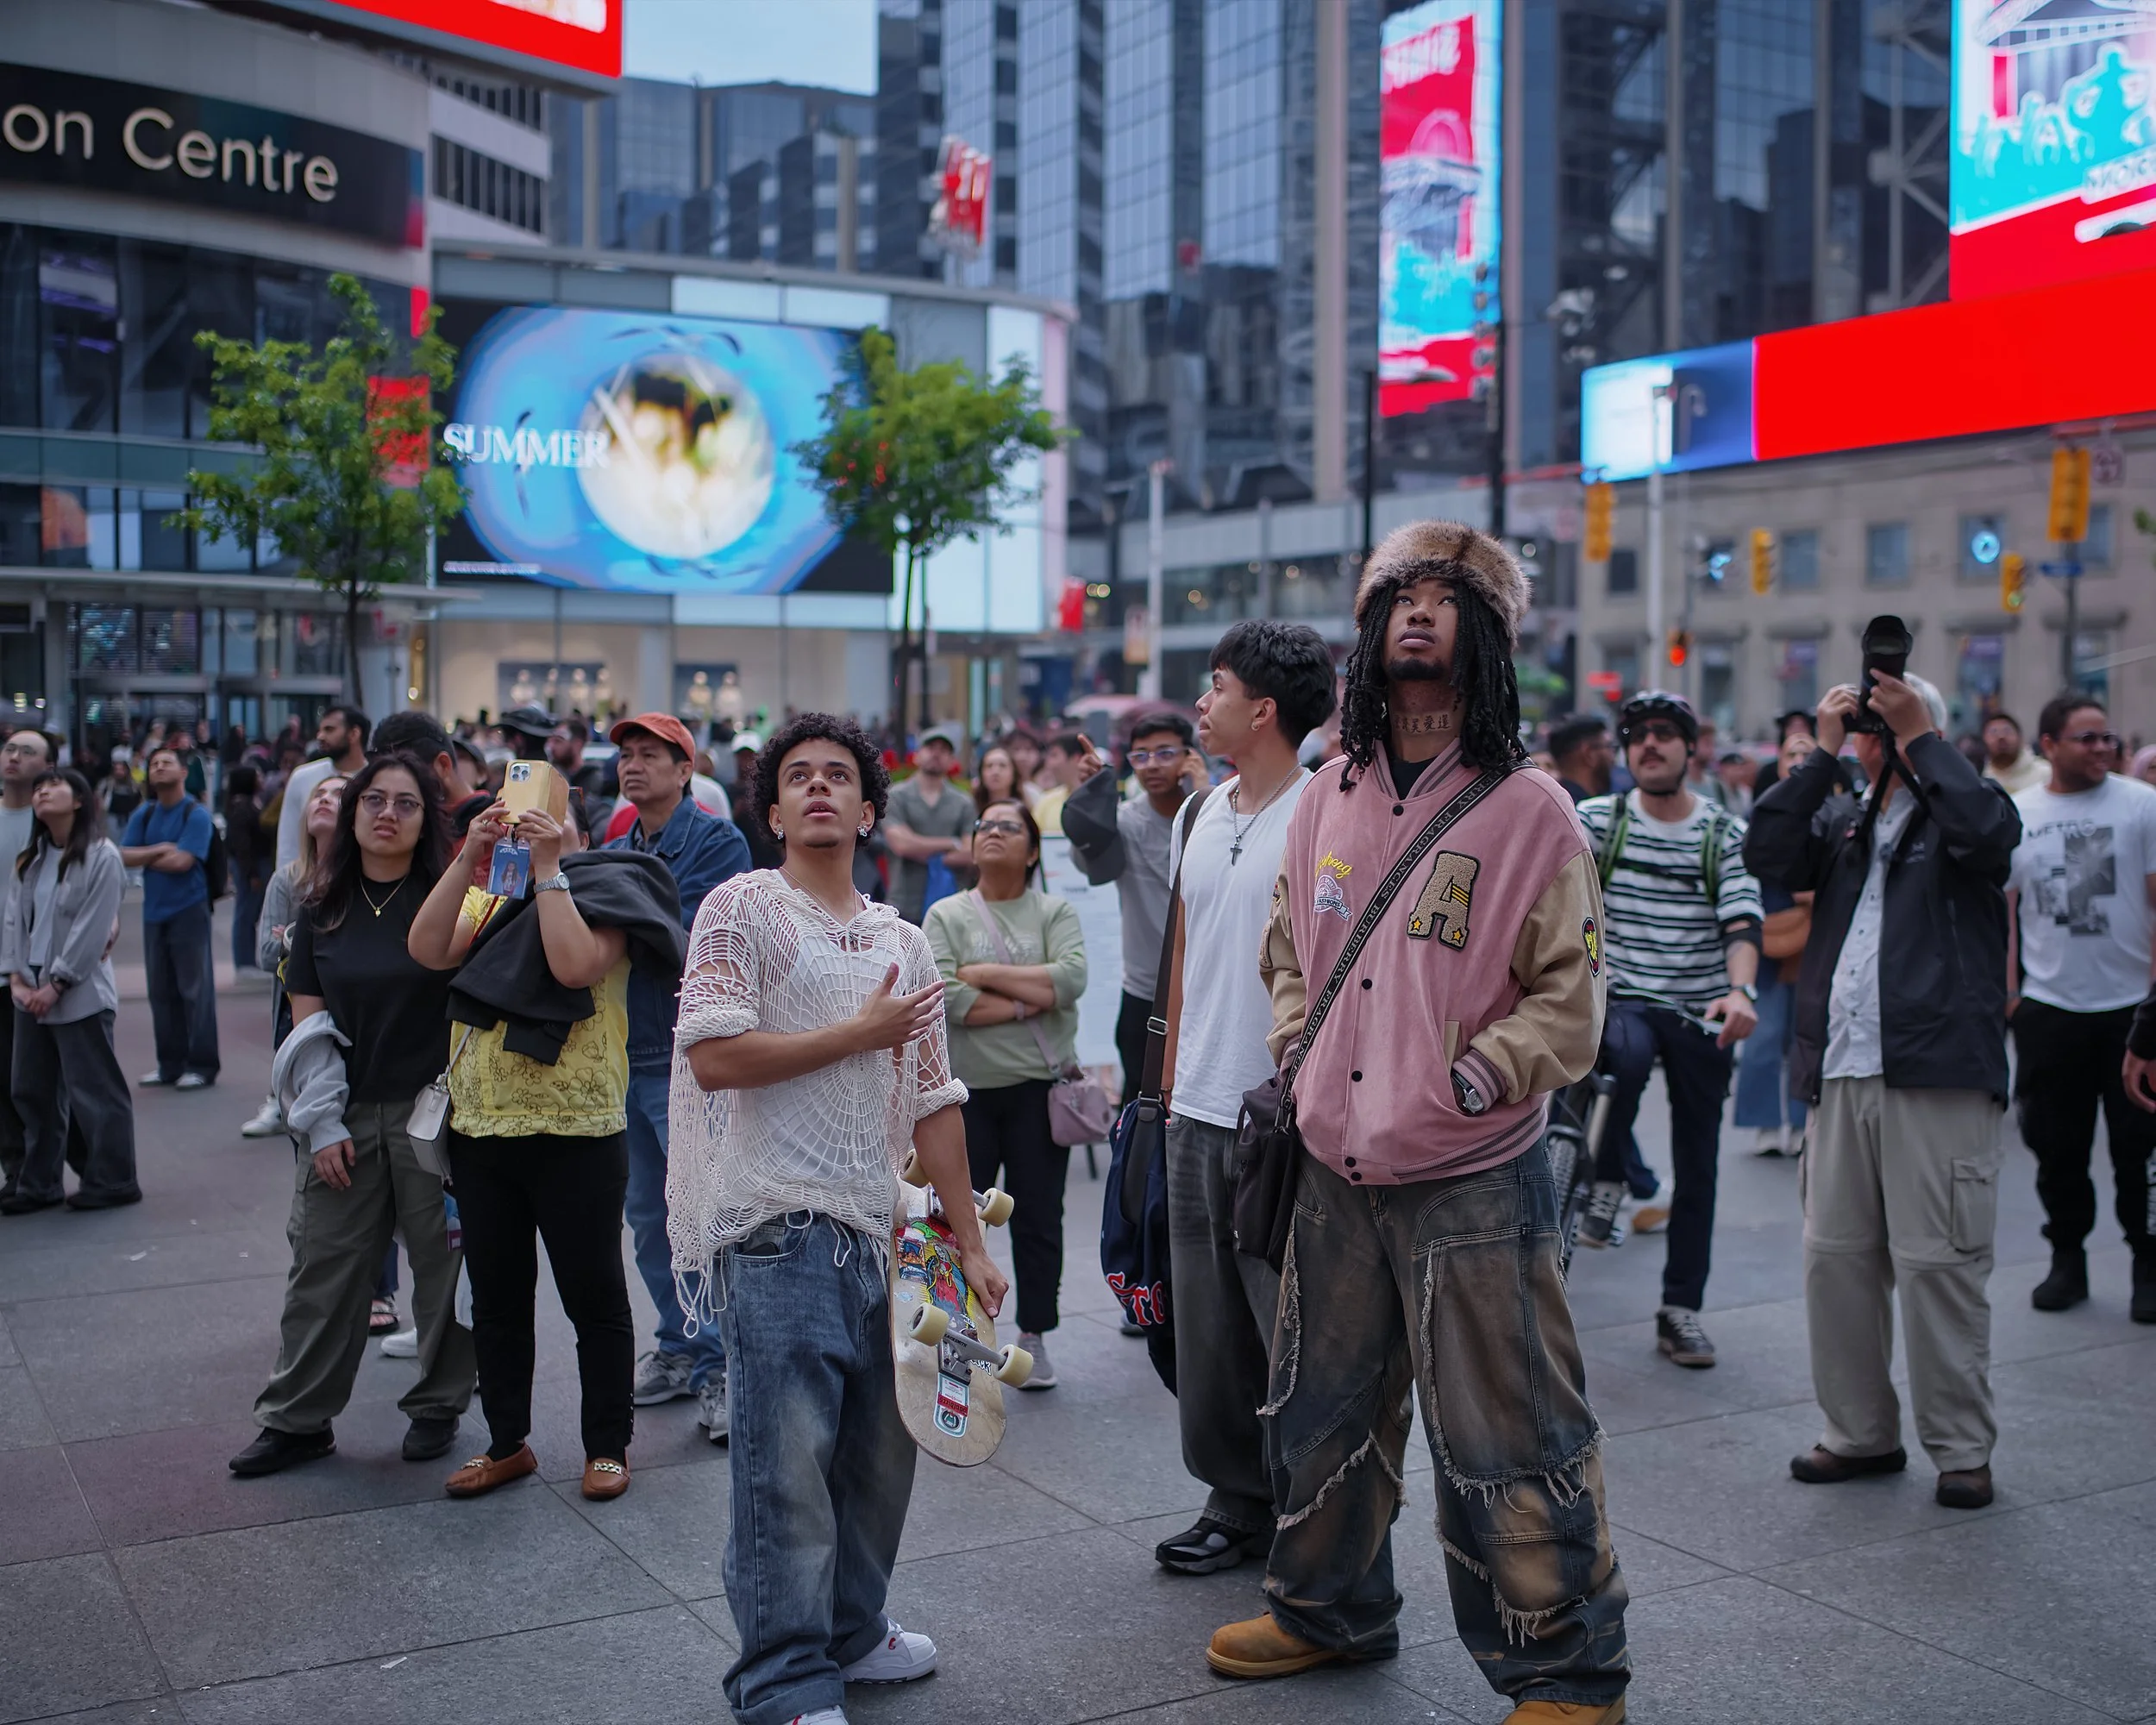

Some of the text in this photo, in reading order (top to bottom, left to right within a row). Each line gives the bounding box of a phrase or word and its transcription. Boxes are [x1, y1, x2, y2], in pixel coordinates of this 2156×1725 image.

[122, 107, 339, 203] Centre
[443, 422, 610, 468] SUMMER
[1381, 812, 1454, 900] FRAGRANCES
[1407, 850, 1480, 950] A
[1333, 904, 1381, 983] BURBERRY
